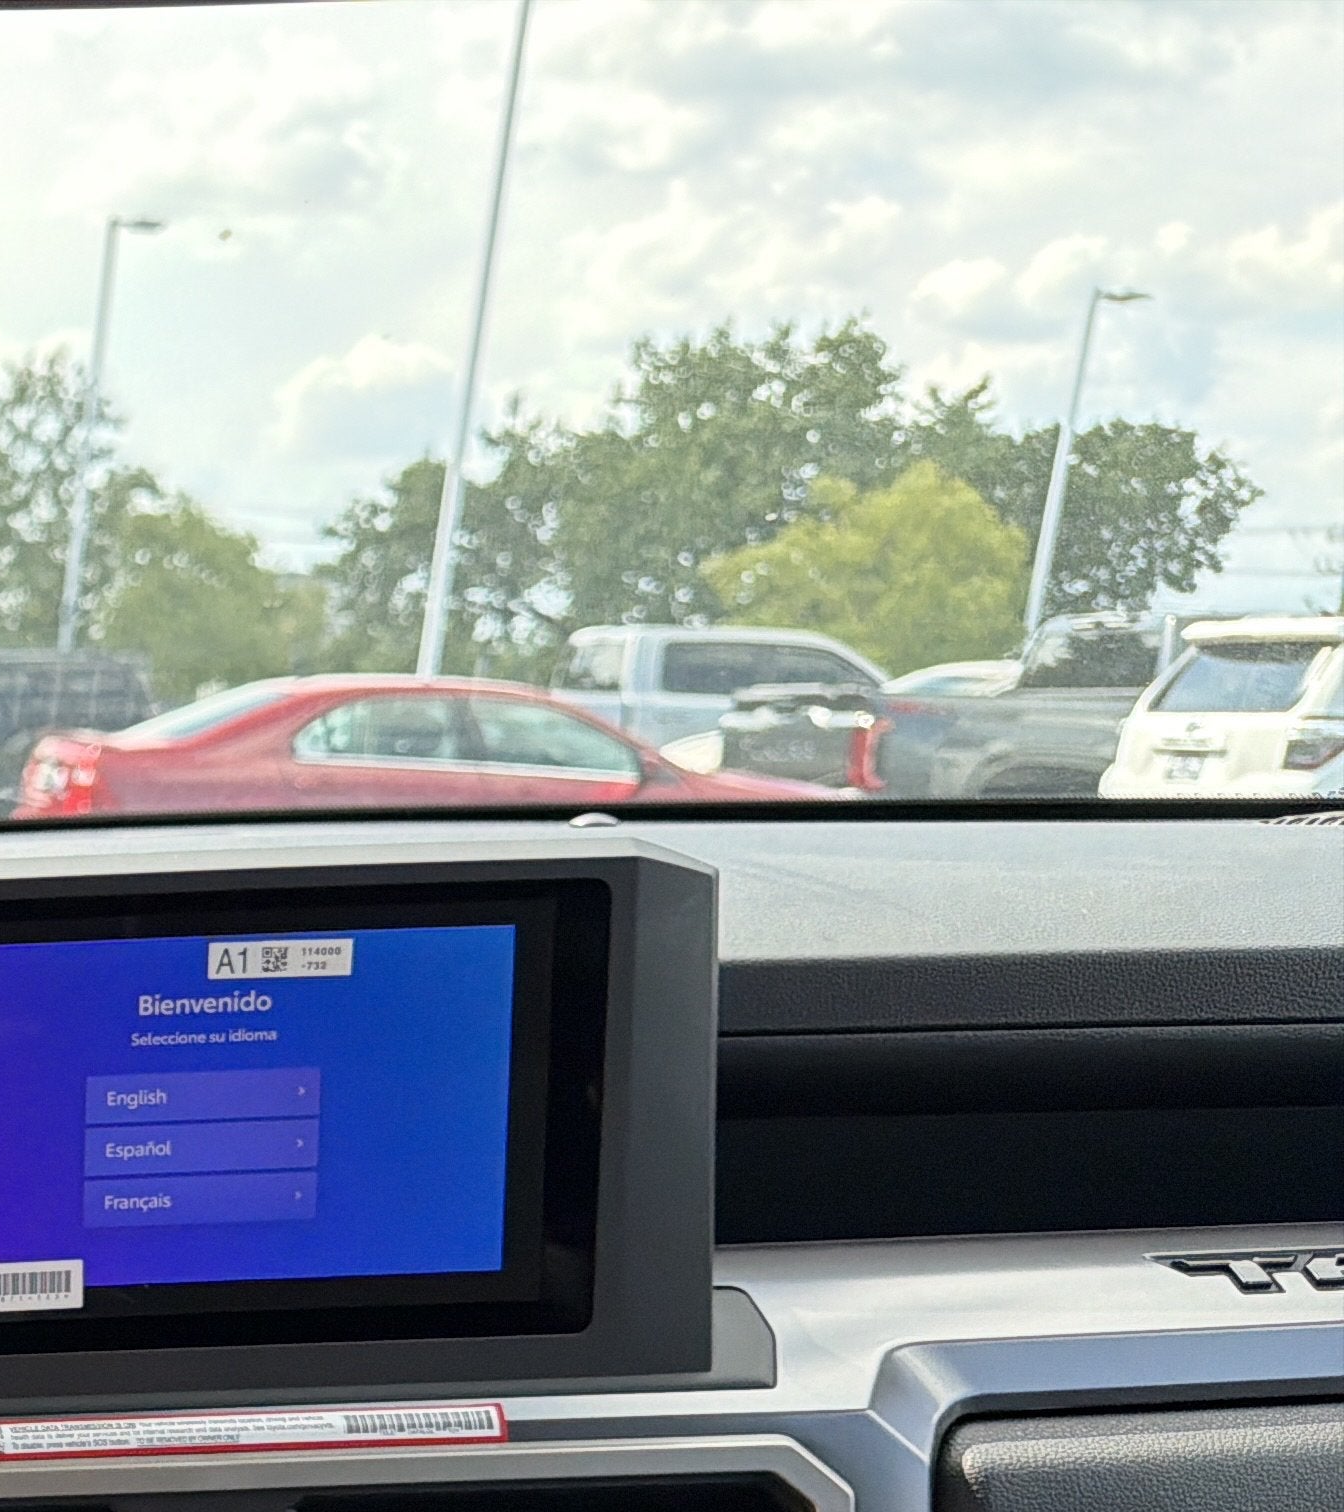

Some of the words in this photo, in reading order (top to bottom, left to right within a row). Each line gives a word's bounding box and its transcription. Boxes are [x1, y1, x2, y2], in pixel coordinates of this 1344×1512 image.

[215, 947, 248, 974] A1
[137, 989, 273, 1017] Bienvenido
[130, 1033, 207, 1047] Seleccione
[209, 1033, 226, 1044] su
[228, 1027, 278, 1042] idioma
[106, 1087, 168, 1110] English
[104, 1140, 172, 1161] Español
[103, 1192, 172, 1213] Français
